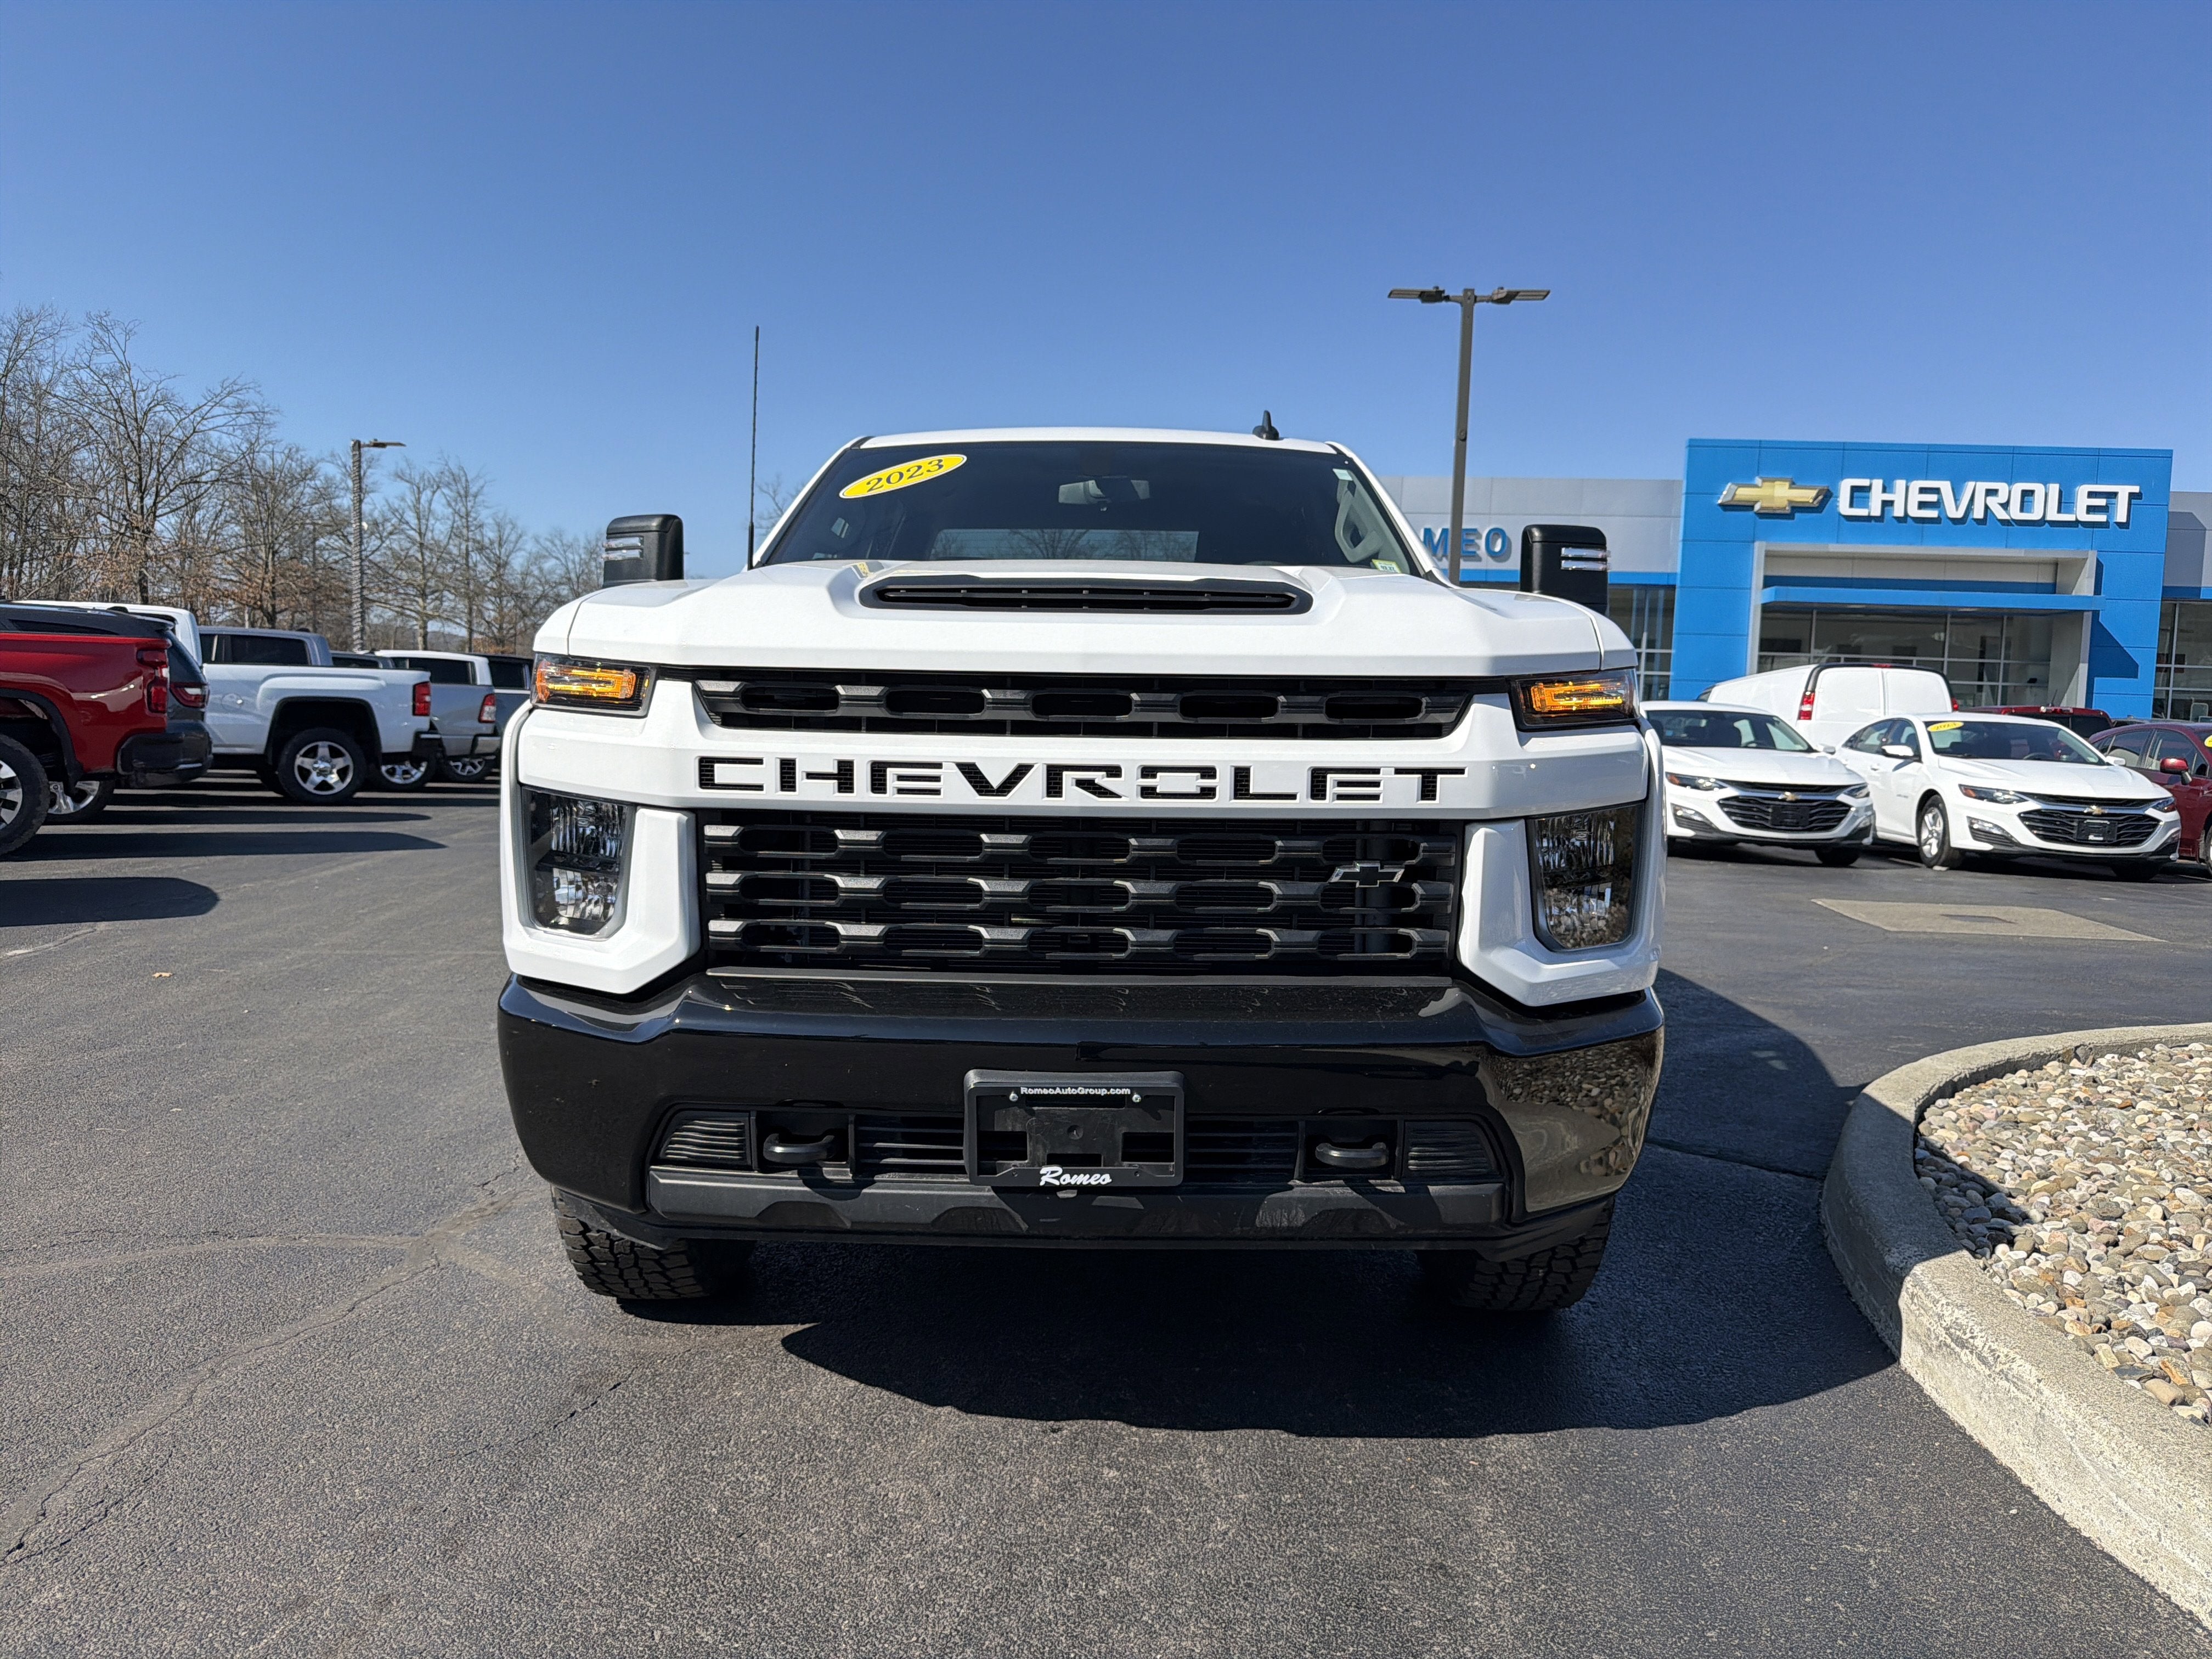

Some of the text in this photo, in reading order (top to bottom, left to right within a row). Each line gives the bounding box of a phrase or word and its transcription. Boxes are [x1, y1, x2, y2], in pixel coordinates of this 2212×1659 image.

[866, 459, 944, 493] 2023
[1839, 478, 2140, 523] CHEVROLET
[698, 756, 1467, 803] CHEVROLET
[1020, 1087, 1131, 1095] RomeoAutoGroup.com
[1040, 1166, 1112, 1186] Romeo
